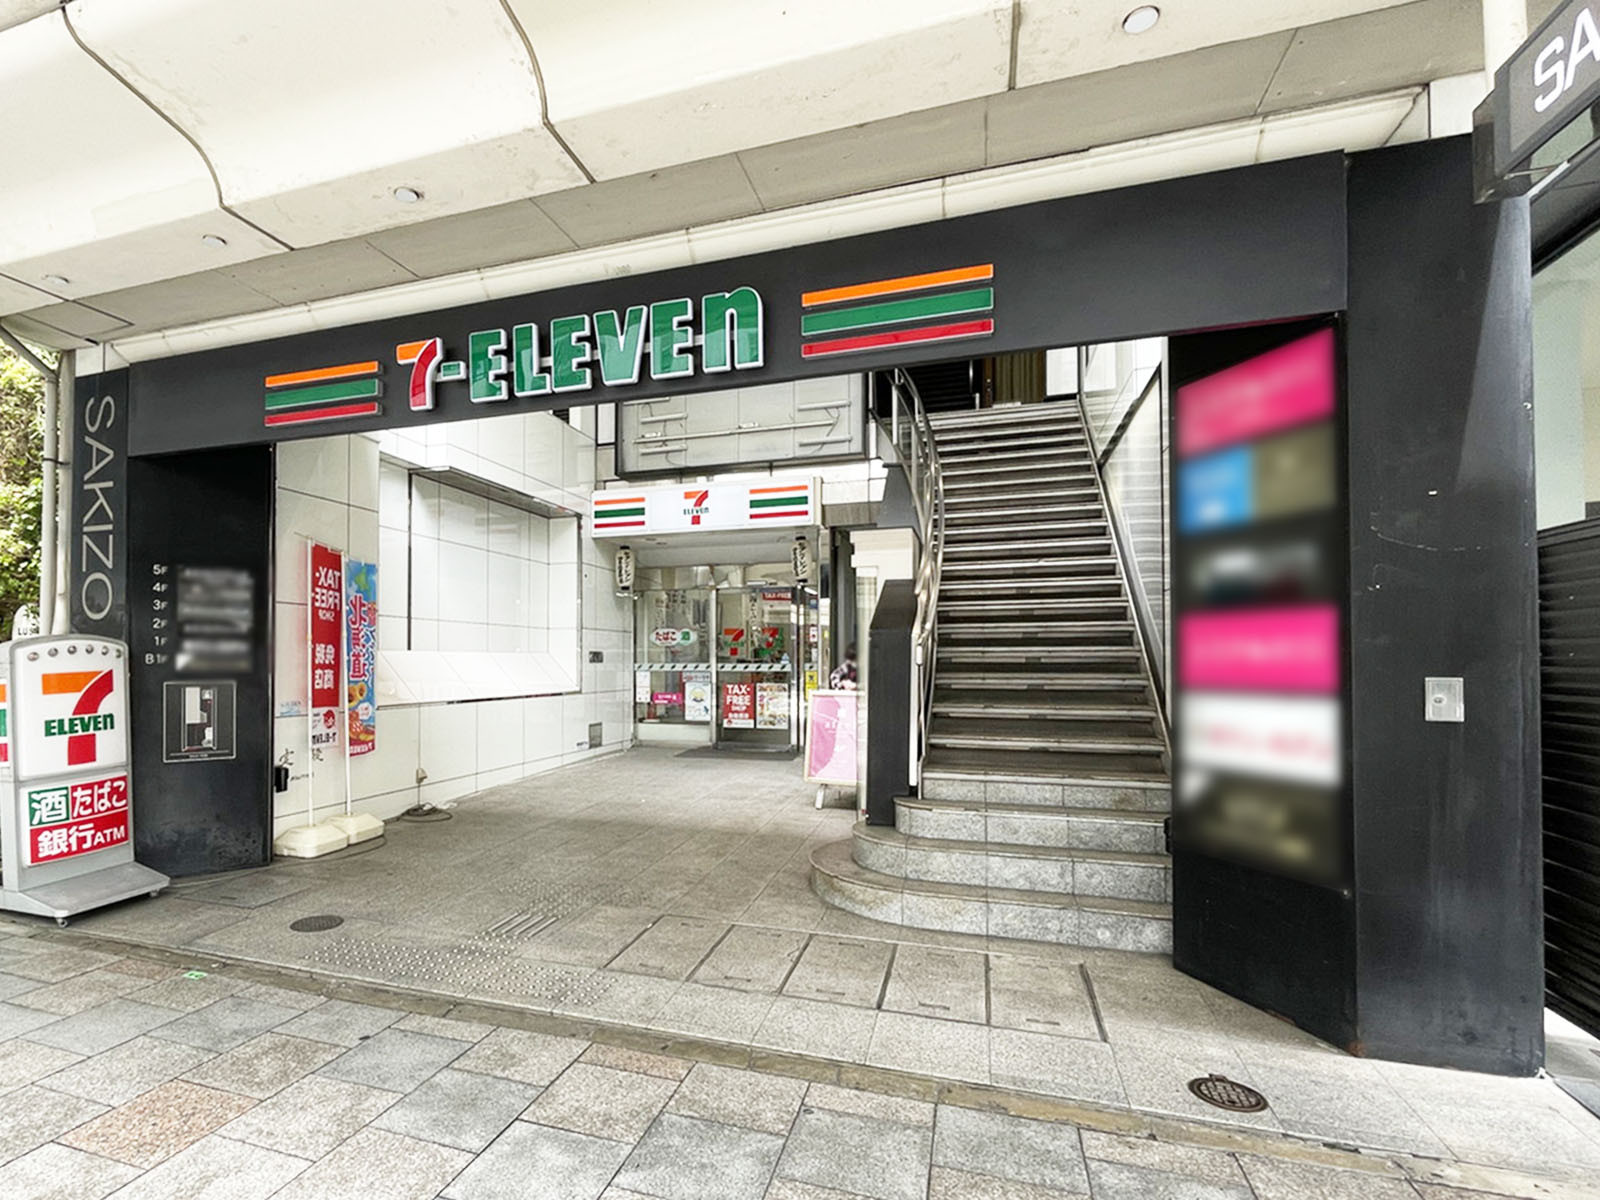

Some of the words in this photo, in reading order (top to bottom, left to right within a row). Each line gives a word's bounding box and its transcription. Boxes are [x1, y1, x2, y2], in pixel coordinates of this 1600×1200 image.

[395, 286, 764, 412] 7-ELEVEN
[81, 394, 116, 621] SAKIZO
[152, 564, 168, 576] 5F
[152, 581, 168, 593] 4F
[152, 599, 168, 611] 3F
[152, 618, 168, 630] 2F
[154, 635, 168, 647] 1F
[145, 653, 169, 665] B1F
[726, 695, 751, 706] FREE
[44, 712, 115, 737] ELEVEN
[30, 787, 68, 826] 酒
[72, 780, 128, 817] たばこ
[37, 823, 126, 858] 銀行ATM
